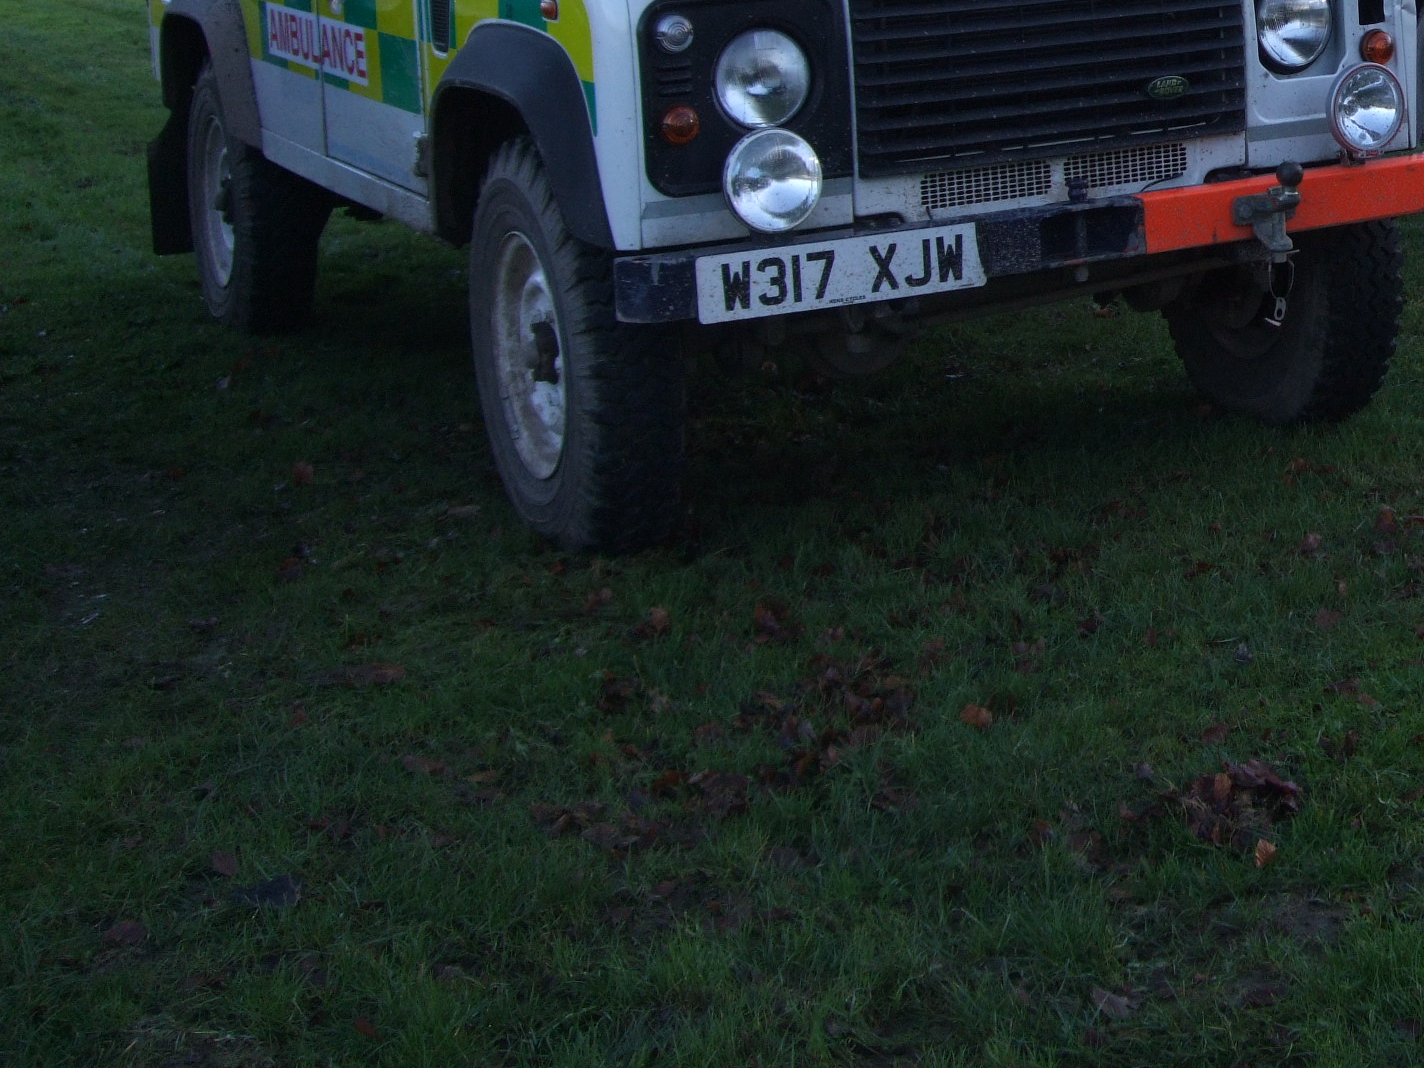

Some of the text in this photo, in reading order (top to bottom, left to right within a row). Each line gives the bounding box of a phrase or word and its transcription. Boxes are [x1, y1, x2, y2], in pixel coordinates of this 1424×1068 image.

[270, 9, 368, 79] AMBULANCE
[720, 233, 963, 312] W317 XJW
